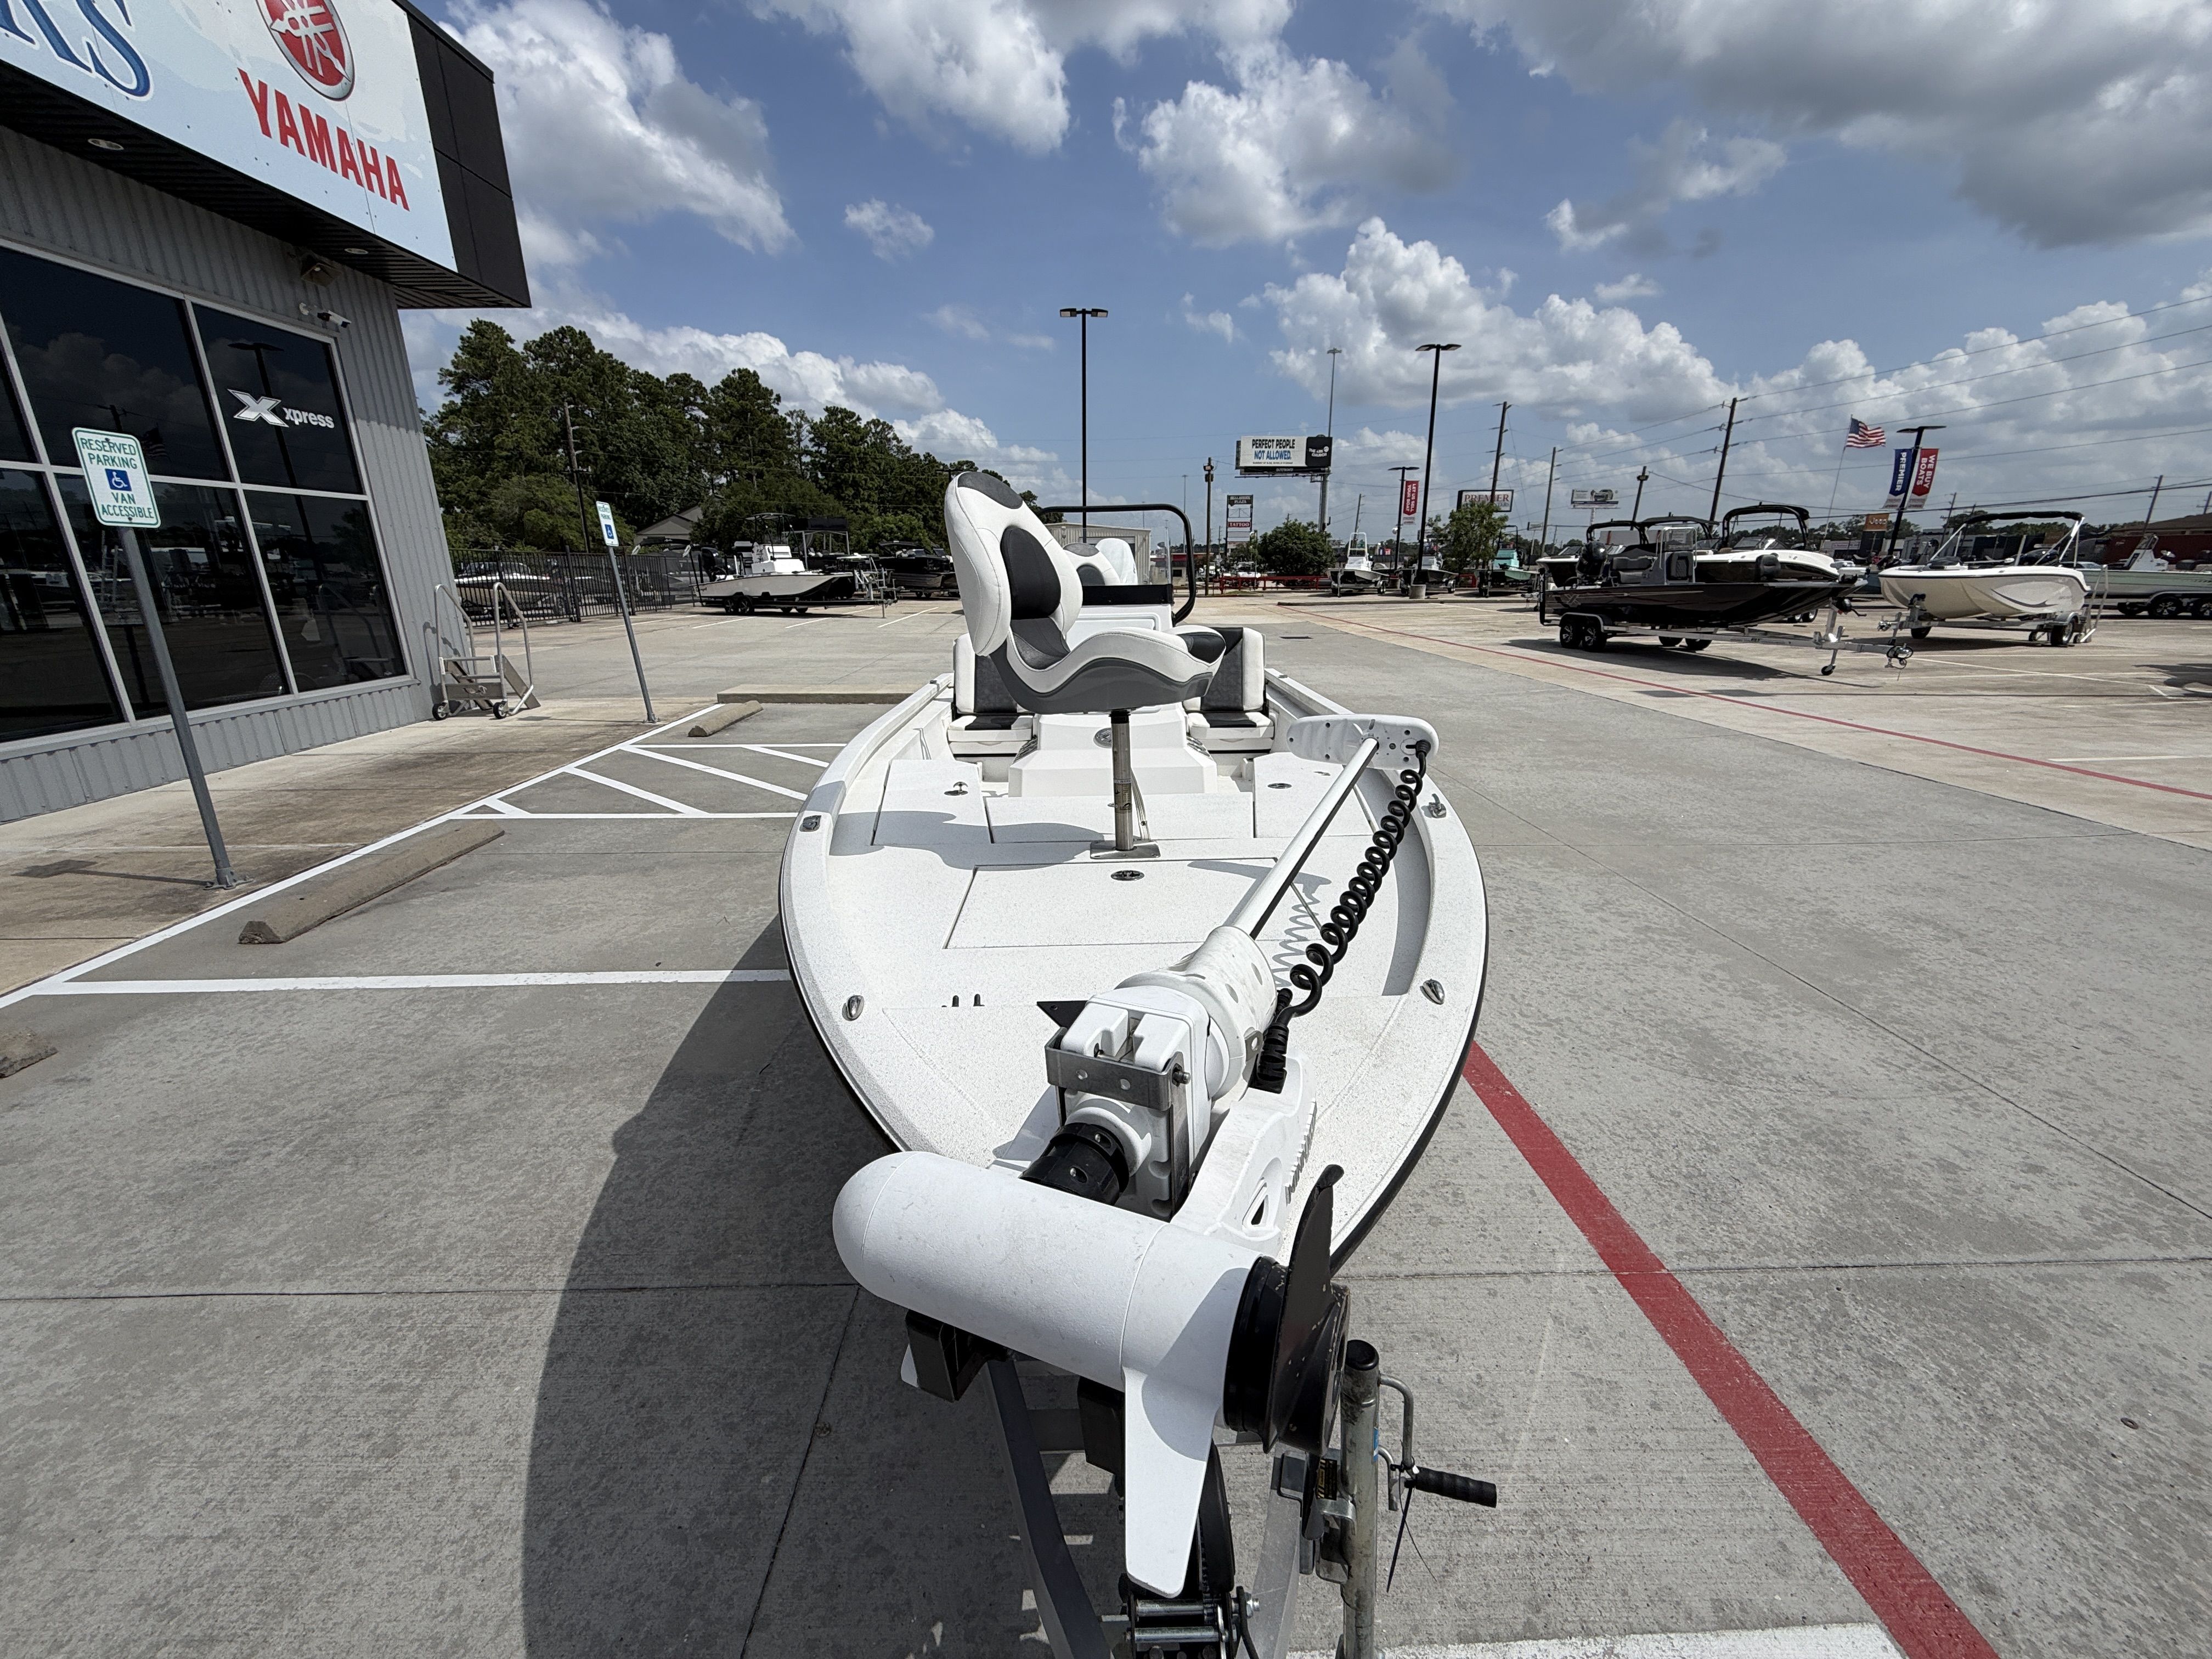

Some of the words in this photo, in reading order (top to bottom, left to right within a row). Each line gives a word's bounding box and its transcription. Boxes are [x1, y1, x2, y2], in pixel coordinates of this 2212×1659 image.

[237, 67, 411, 212] YAMAHA
[282, 407, 335, 428] xpress
[80, 437, 137, 455] RESERVED
[1252, 439, 1275, 449] PERFECT
[1276, 439, 1295, 449] PEOPLE
[88, 453, 138, 470] PARKING
[1254, 450, 1265, 460] NOT
[1266, 450, 1291, 460] ALLOWED.
[1927, 454, 1936, 469] WE
[1895, 452, 1907, 491] PREMIER
[1916, 458, 1928, 486] BOATS
[1923, 471, 1933, 488] BUY
[111, 492, 137, 505] VAN
[101, 504, 155, 519] ACCESSIBLE
